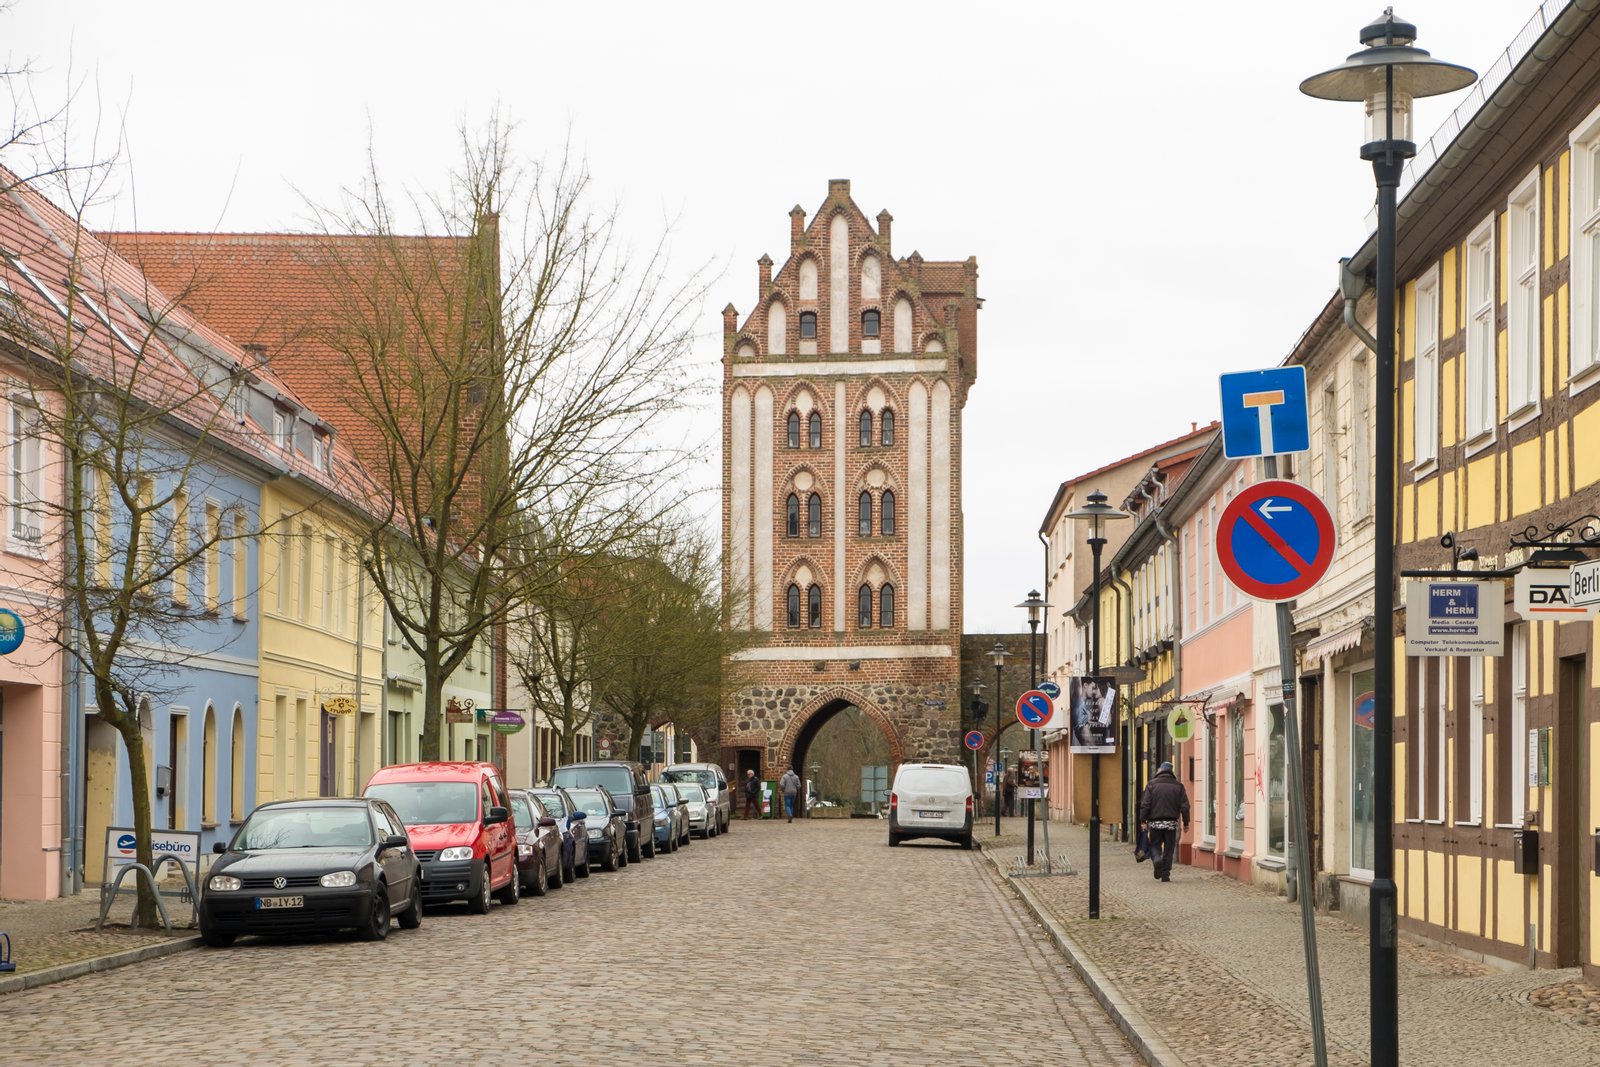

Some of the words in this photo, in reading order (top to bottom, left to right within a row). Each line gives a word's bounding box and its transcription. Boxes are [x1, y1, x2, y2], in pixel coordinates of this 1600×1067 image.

[1574, 567, 1599, 596] Berli
[1530, 585, 1569, 604] DA
[152, 840, 191, 852] isebüro
[260, 898, 272, 908] NB
[292, 898, 302, 906] 12
